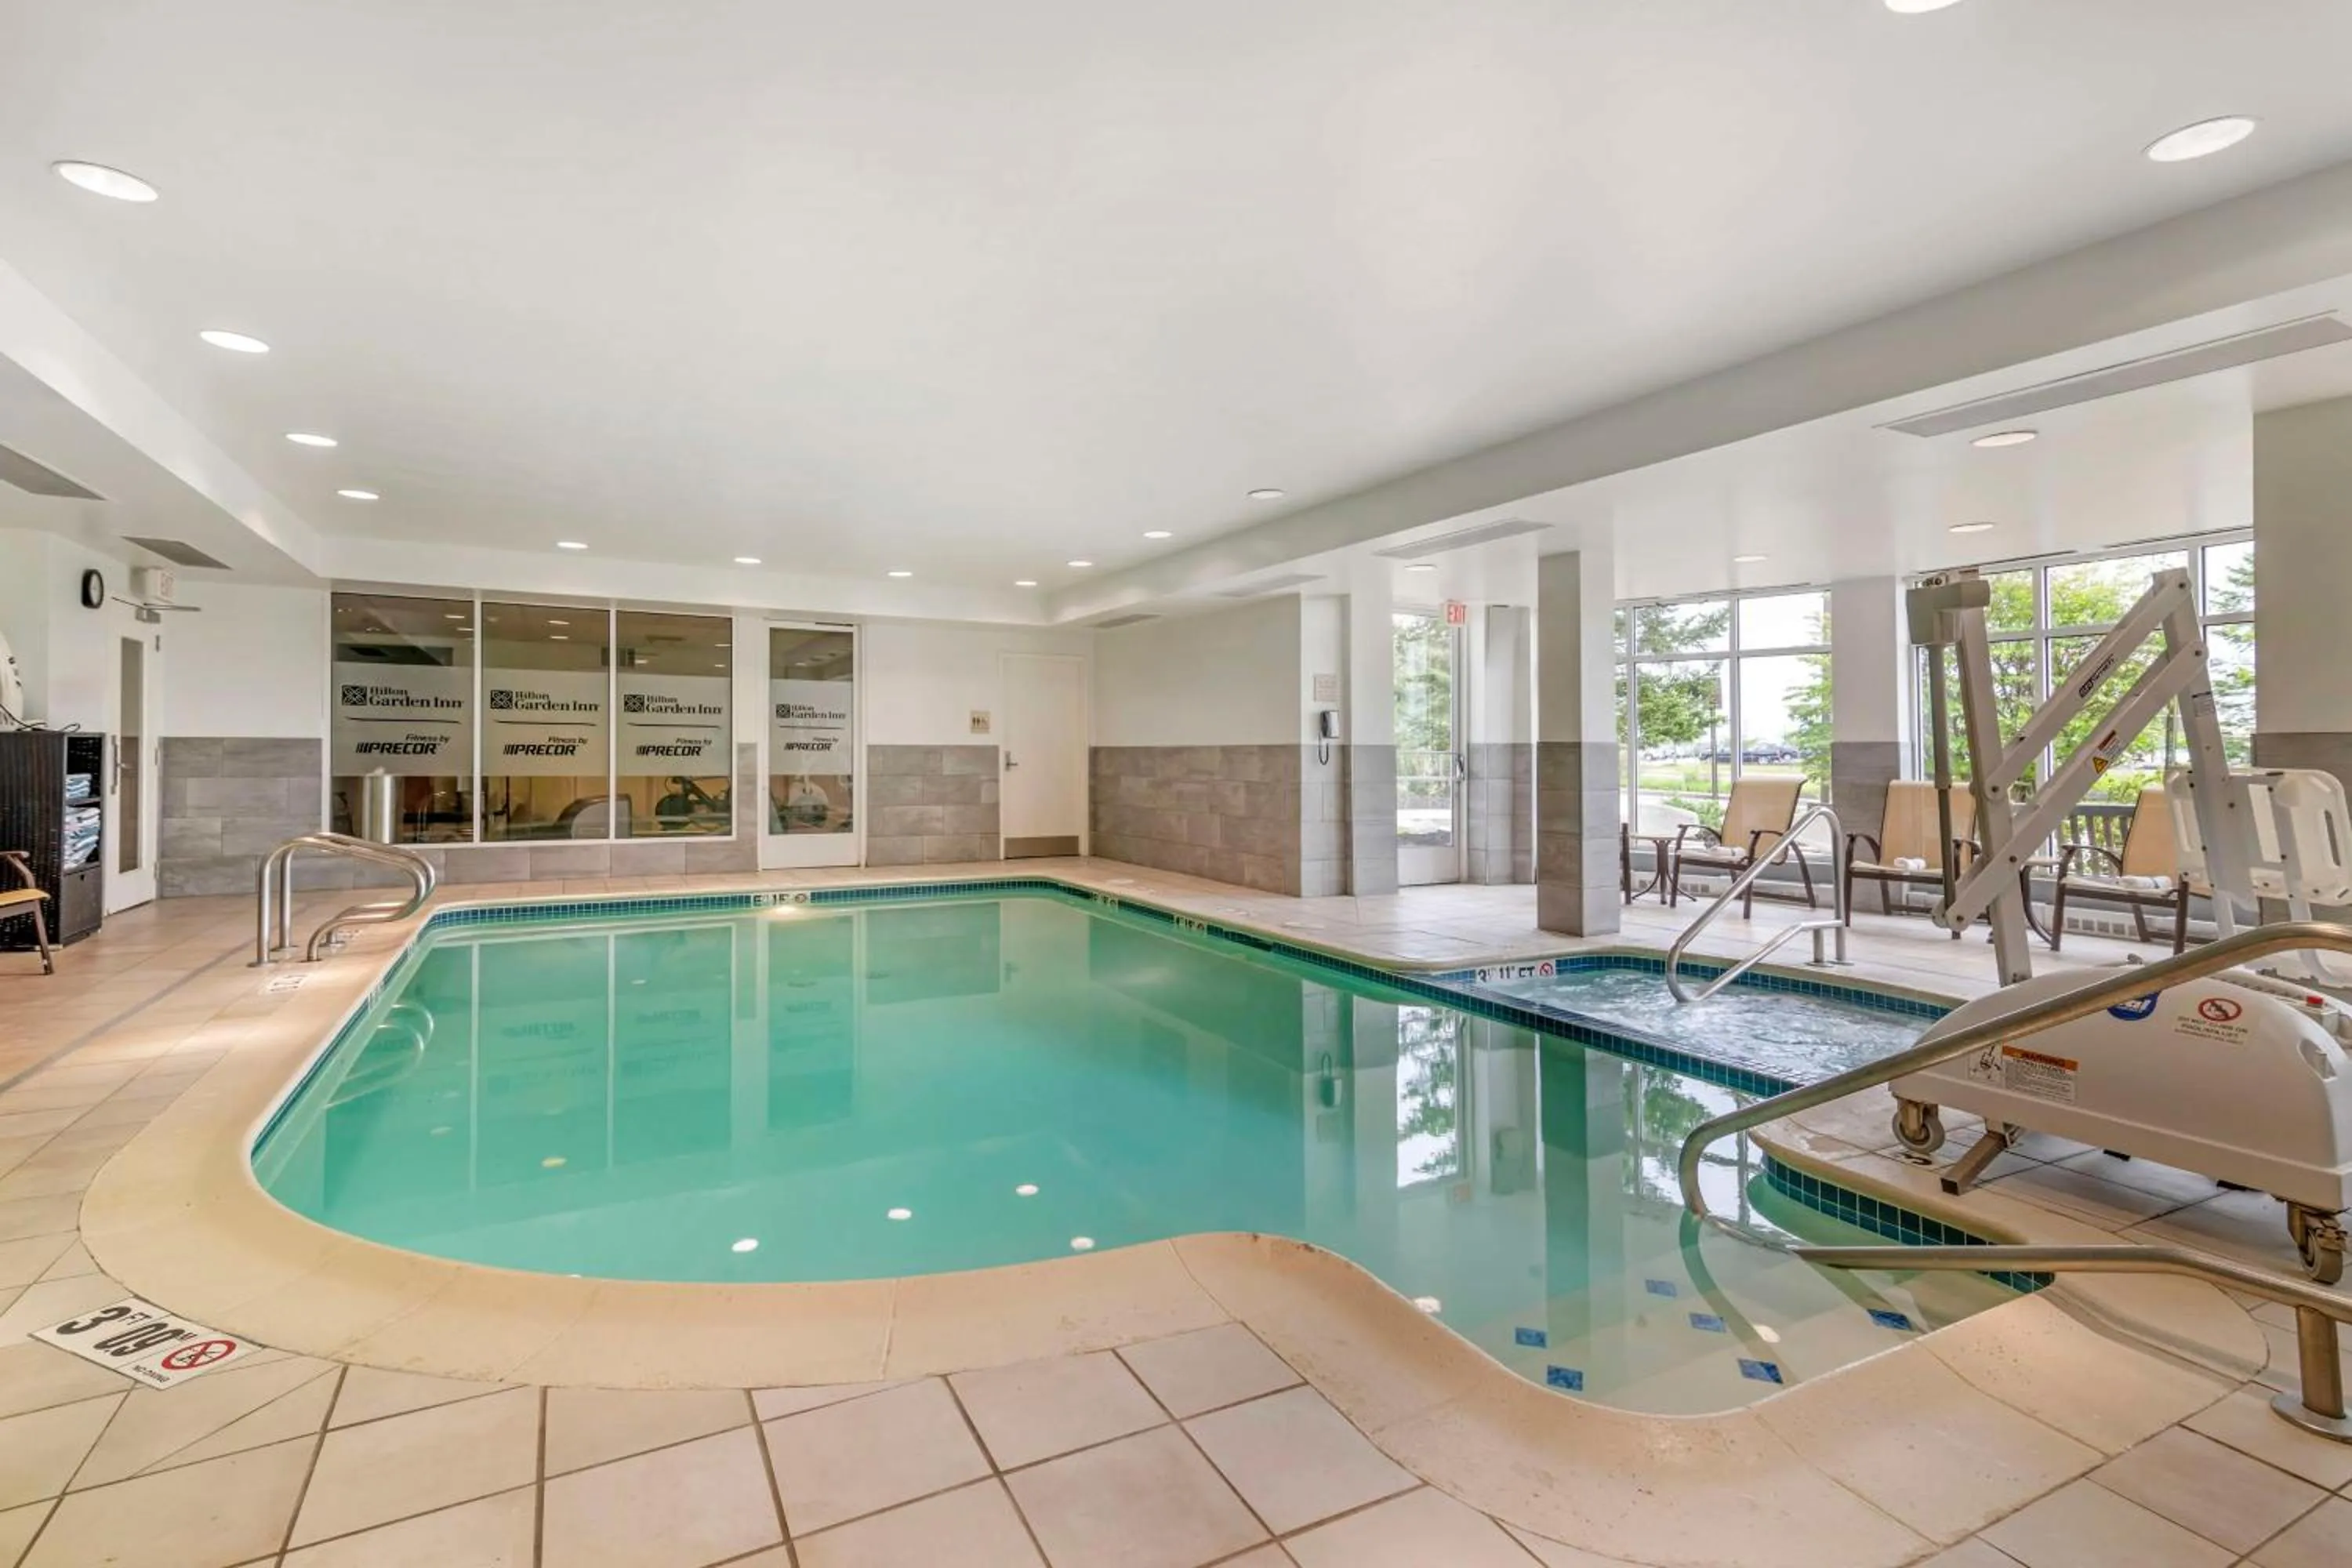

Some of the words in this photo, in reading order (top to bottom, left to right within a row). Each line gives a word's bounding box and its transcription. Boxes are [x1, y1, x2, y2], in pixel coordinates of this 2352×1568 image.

[1447, 604, 1466, 625] EXIT
[369, 695, 430, 708] Garden
[434, 697, 463, 708] Inn
[514, 699, 570, 711] Garden
[572, 700, 598, 712] Inn
[646, 704, 695, 714] Garden
[699, 704, 721, 714] Inn
[405, 733, 437, 742] Fitness
[439, 735, 450, 744] by
[367, 742, 437, 755] PRECOR
[514, 744, 576, 755] PRECOR
[645, 746, 702, 756] PRECOR
[56, 1306, 132, 1334] 3
[118, 1312, 152, 1325] FT
